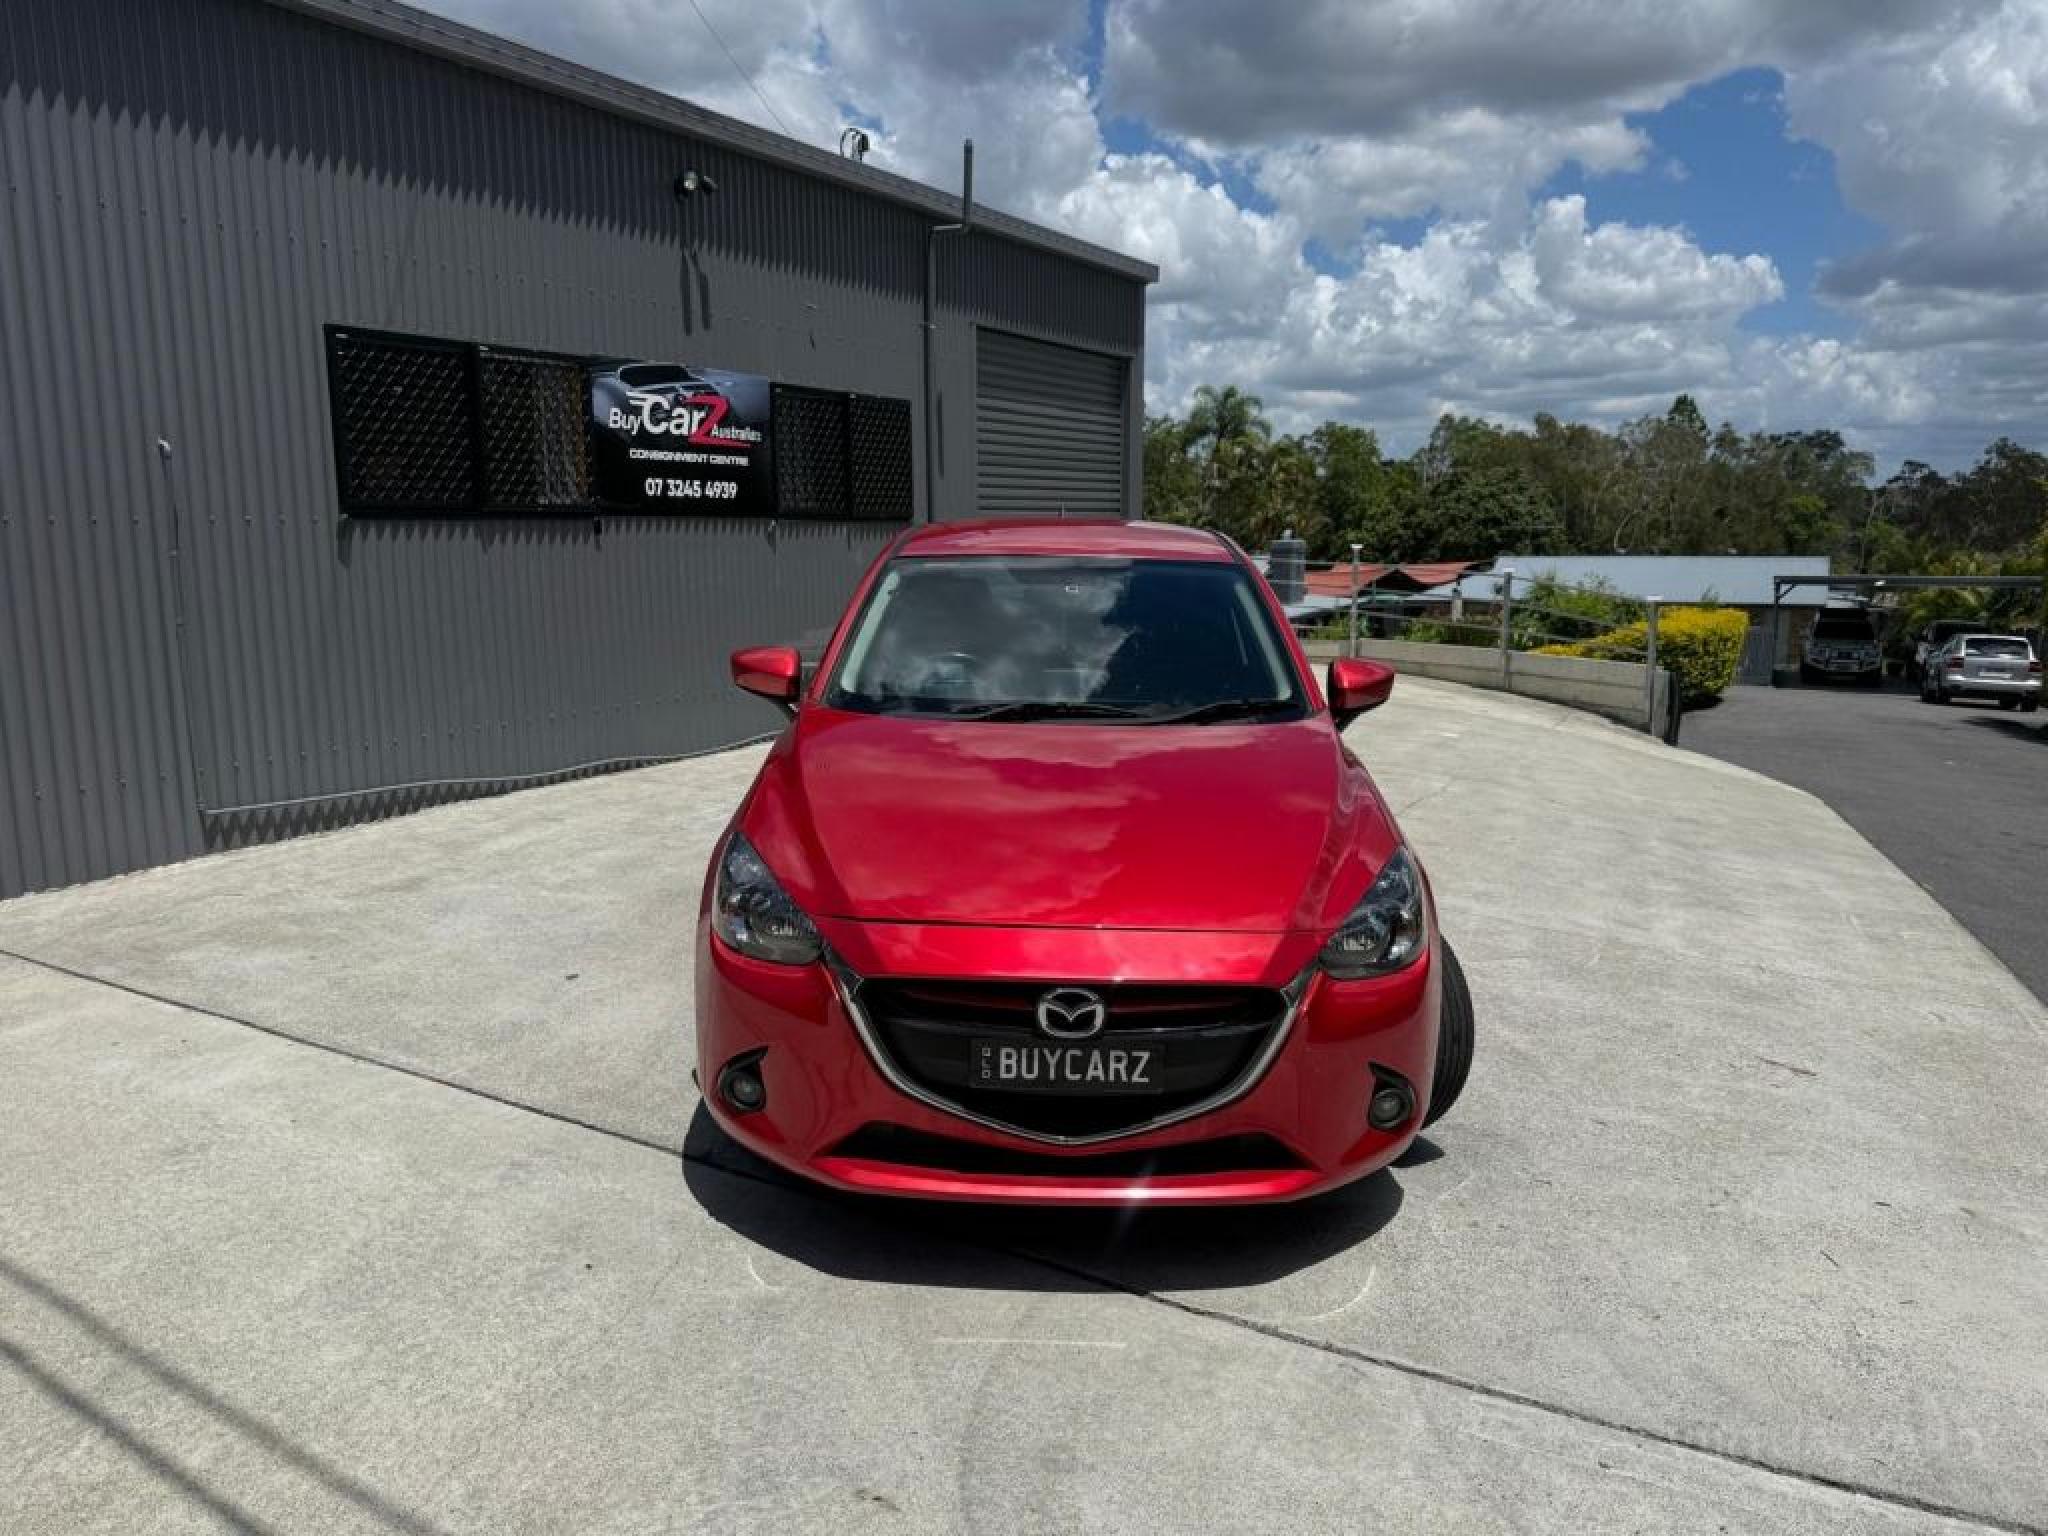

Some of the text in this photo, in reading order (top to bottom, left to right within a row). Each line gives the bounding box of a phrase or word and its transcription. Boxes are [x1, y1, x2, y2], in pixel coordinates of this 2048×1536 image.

[629, 448, 749, 466] CONSIGNMENT CENTRE
[645, 478, 737, 499] 07 3245 4939
[1000, 1047, 1150, 1083] BUYCARZ
